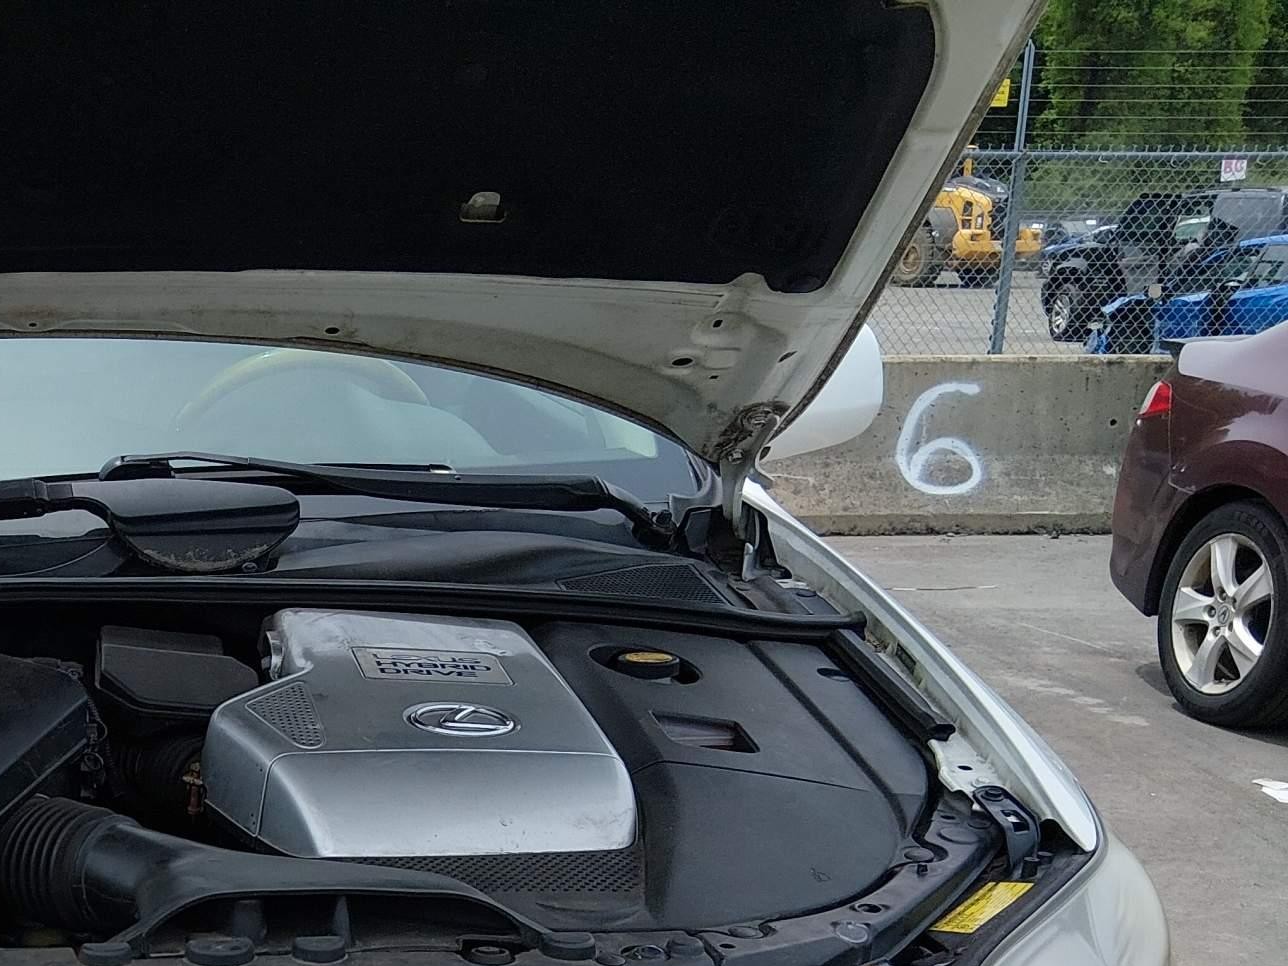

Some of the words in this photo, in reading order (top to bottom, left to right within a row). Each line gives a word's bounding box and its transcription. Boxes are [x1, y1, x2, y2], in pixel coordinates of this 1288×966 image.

[895, 383, 981, 495] 6
[372, 653, 481, 664] LEXUS
[375, 660, 491, 672] HYBRID
[378, 667, 480, 678] DRIVE
